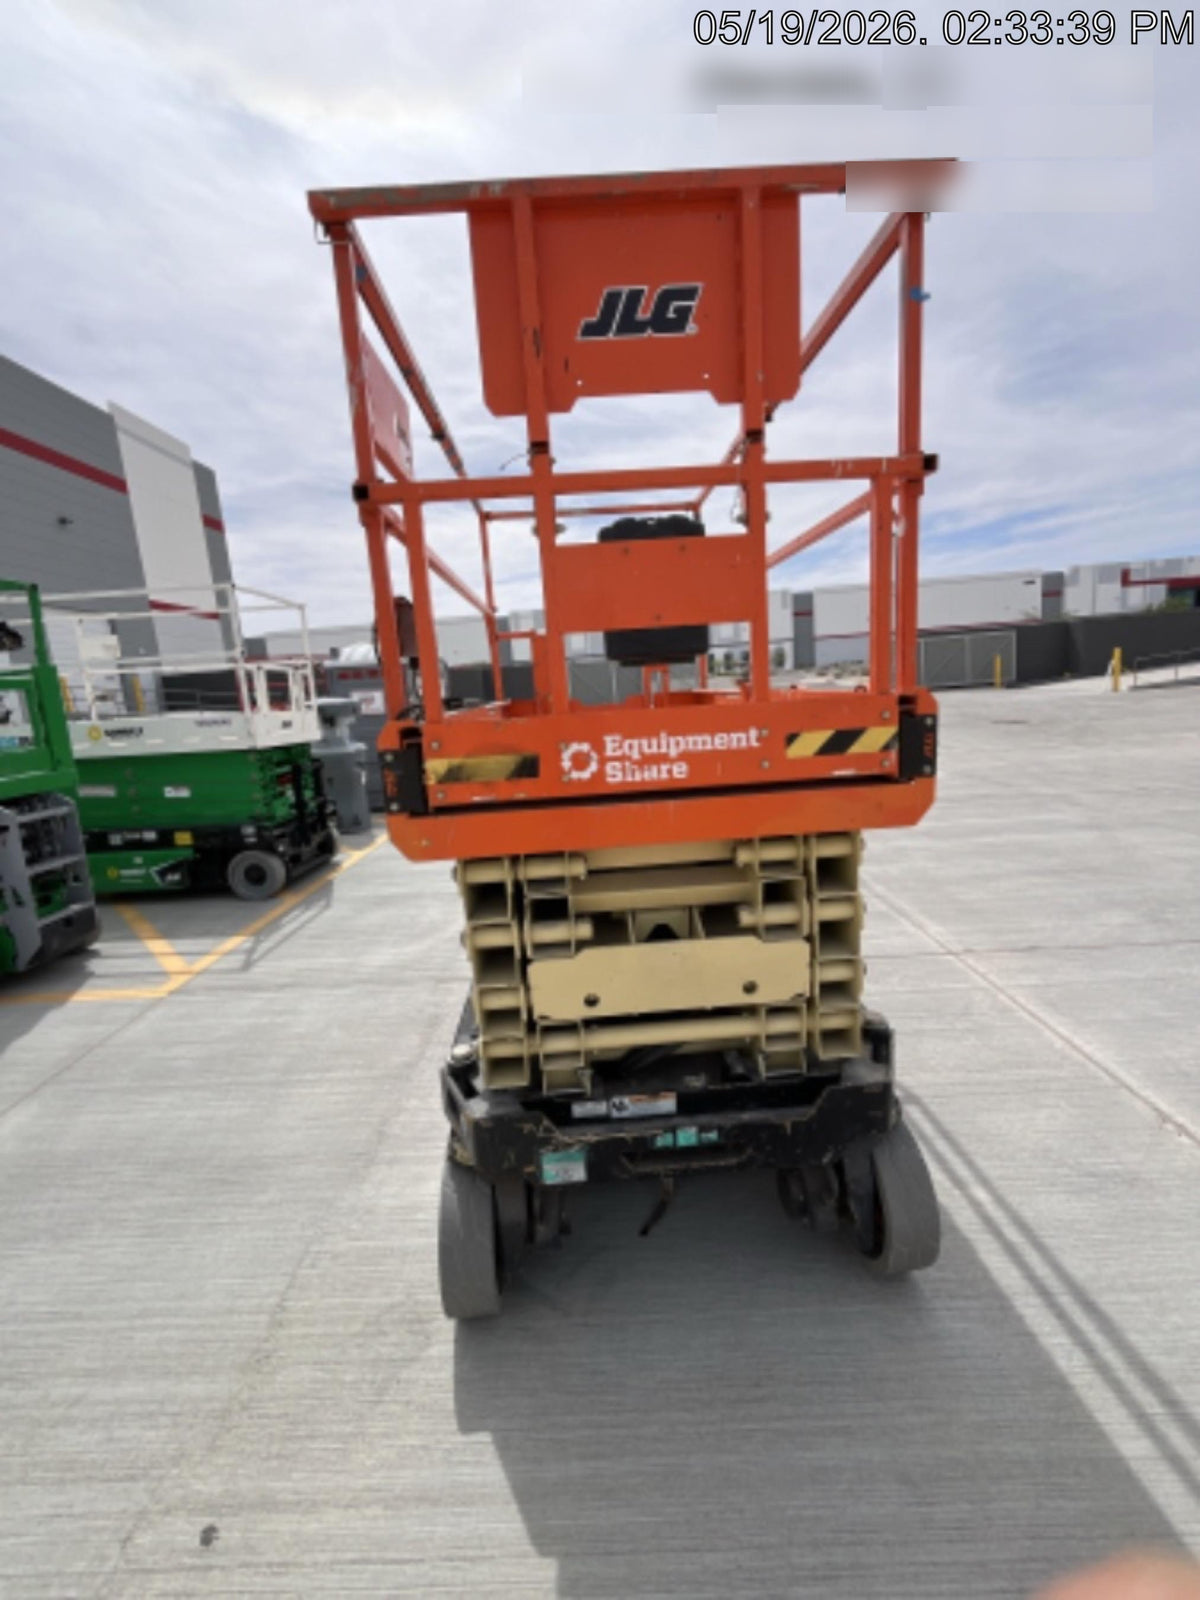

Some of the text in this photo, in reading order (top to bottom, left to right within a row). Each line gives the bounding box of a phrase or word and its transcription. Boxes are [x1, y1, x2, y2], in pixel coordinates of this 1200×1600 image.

[576, 282, 704, 341] JLG
[603, 726, 761, 760] Equipment
[604, 761, 689, 784] Share
